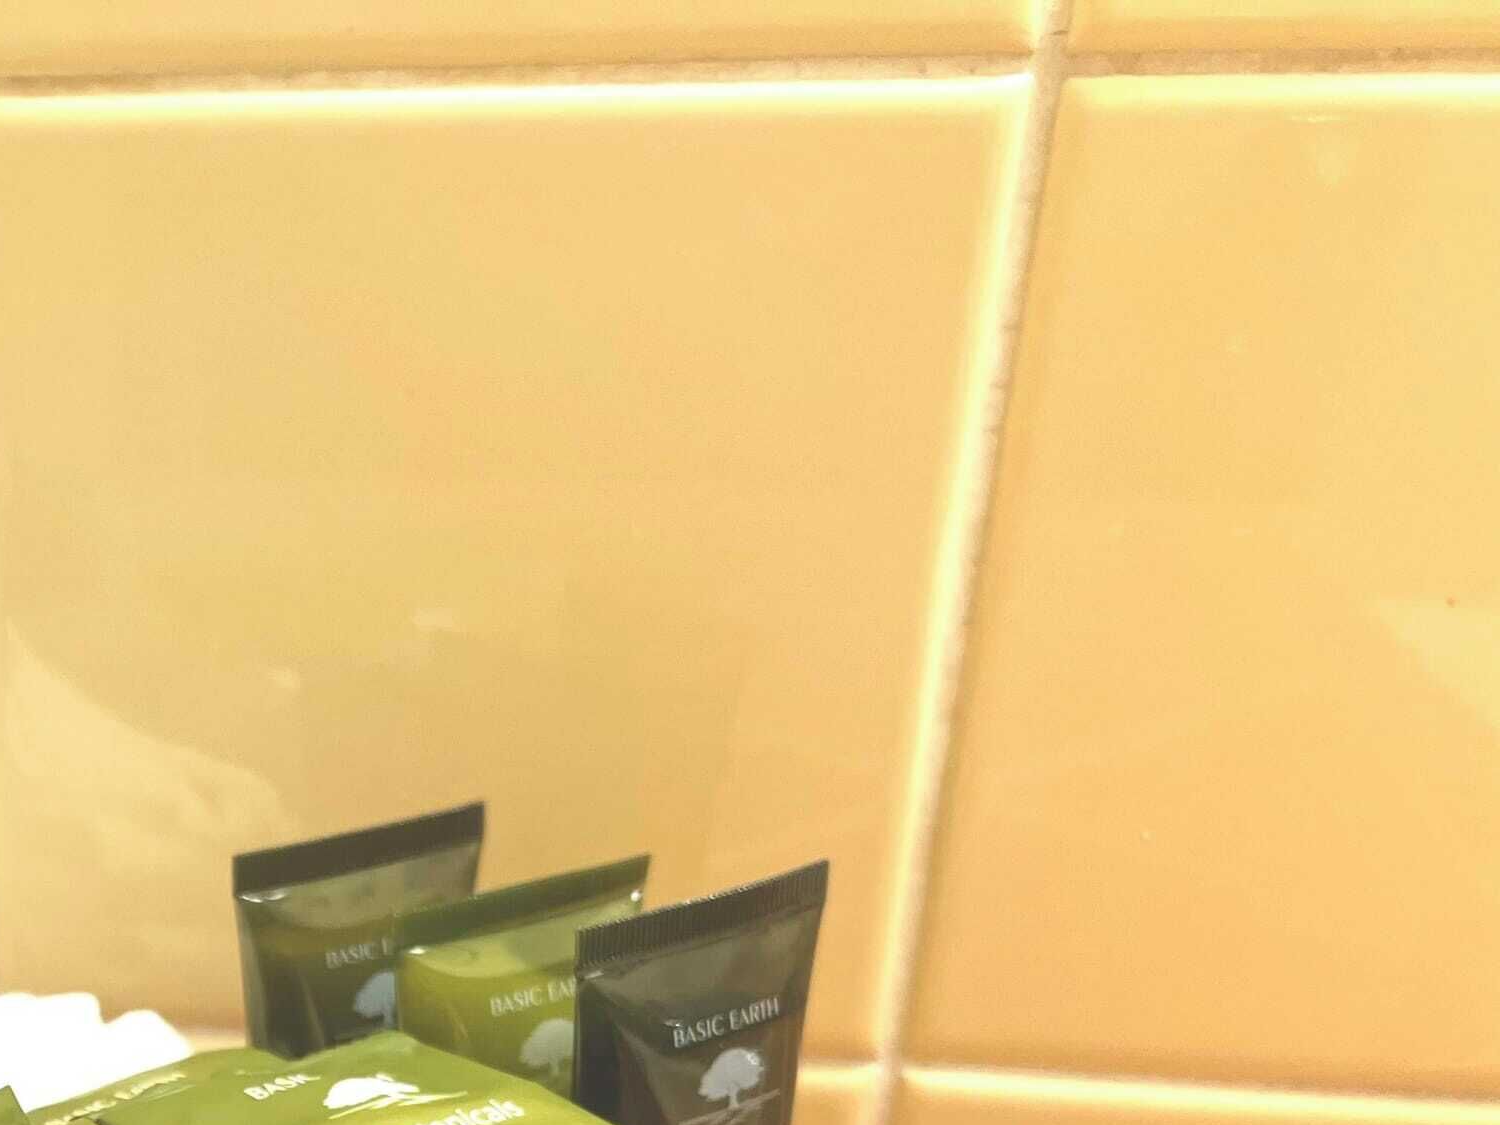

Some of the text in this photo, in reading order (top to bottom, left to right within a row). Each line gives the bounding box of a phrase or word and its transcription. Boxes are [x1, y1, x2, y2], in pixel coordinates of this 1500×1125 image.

[490, 986, 542, 1017] BASIC
[673, 997, 780, 1048] BASIC EARTH
